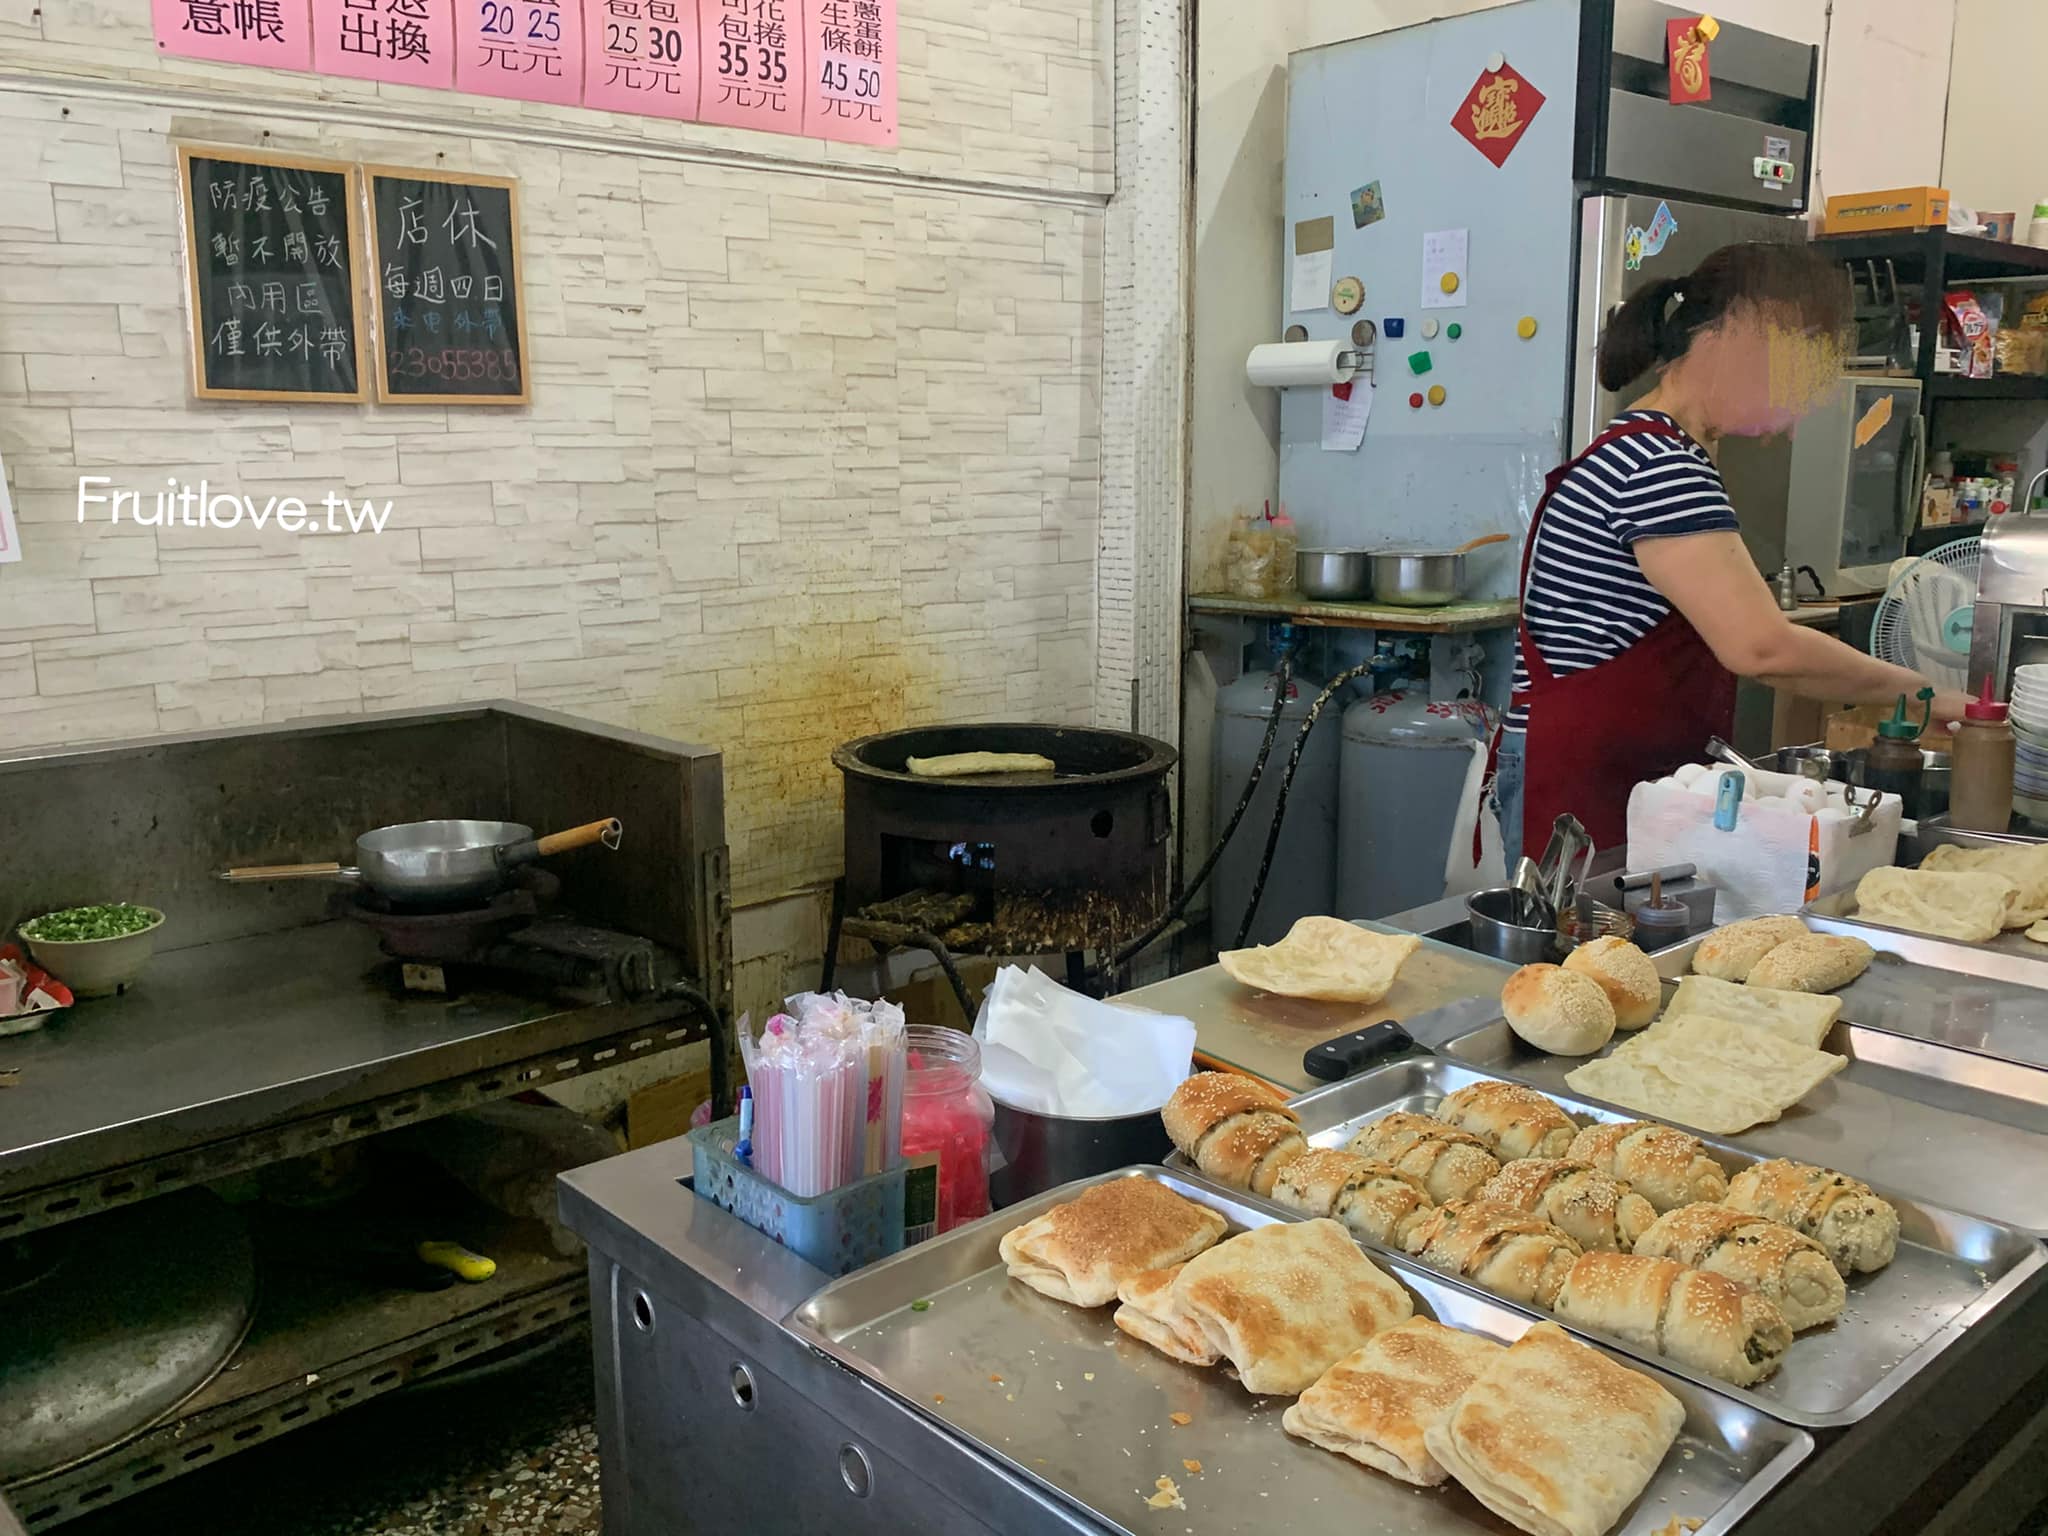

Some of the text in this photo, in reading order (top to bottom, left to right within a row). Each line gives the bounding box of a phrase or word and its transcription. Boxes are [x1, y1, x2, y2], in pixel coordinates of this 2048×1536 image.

[209, 176, 330, 216] 防疫公告
[397, 196, 497, 249] 店休
[211, 232, 344, 270] 暫不開放
[211, 315, 348, 370] 僅供外帶
